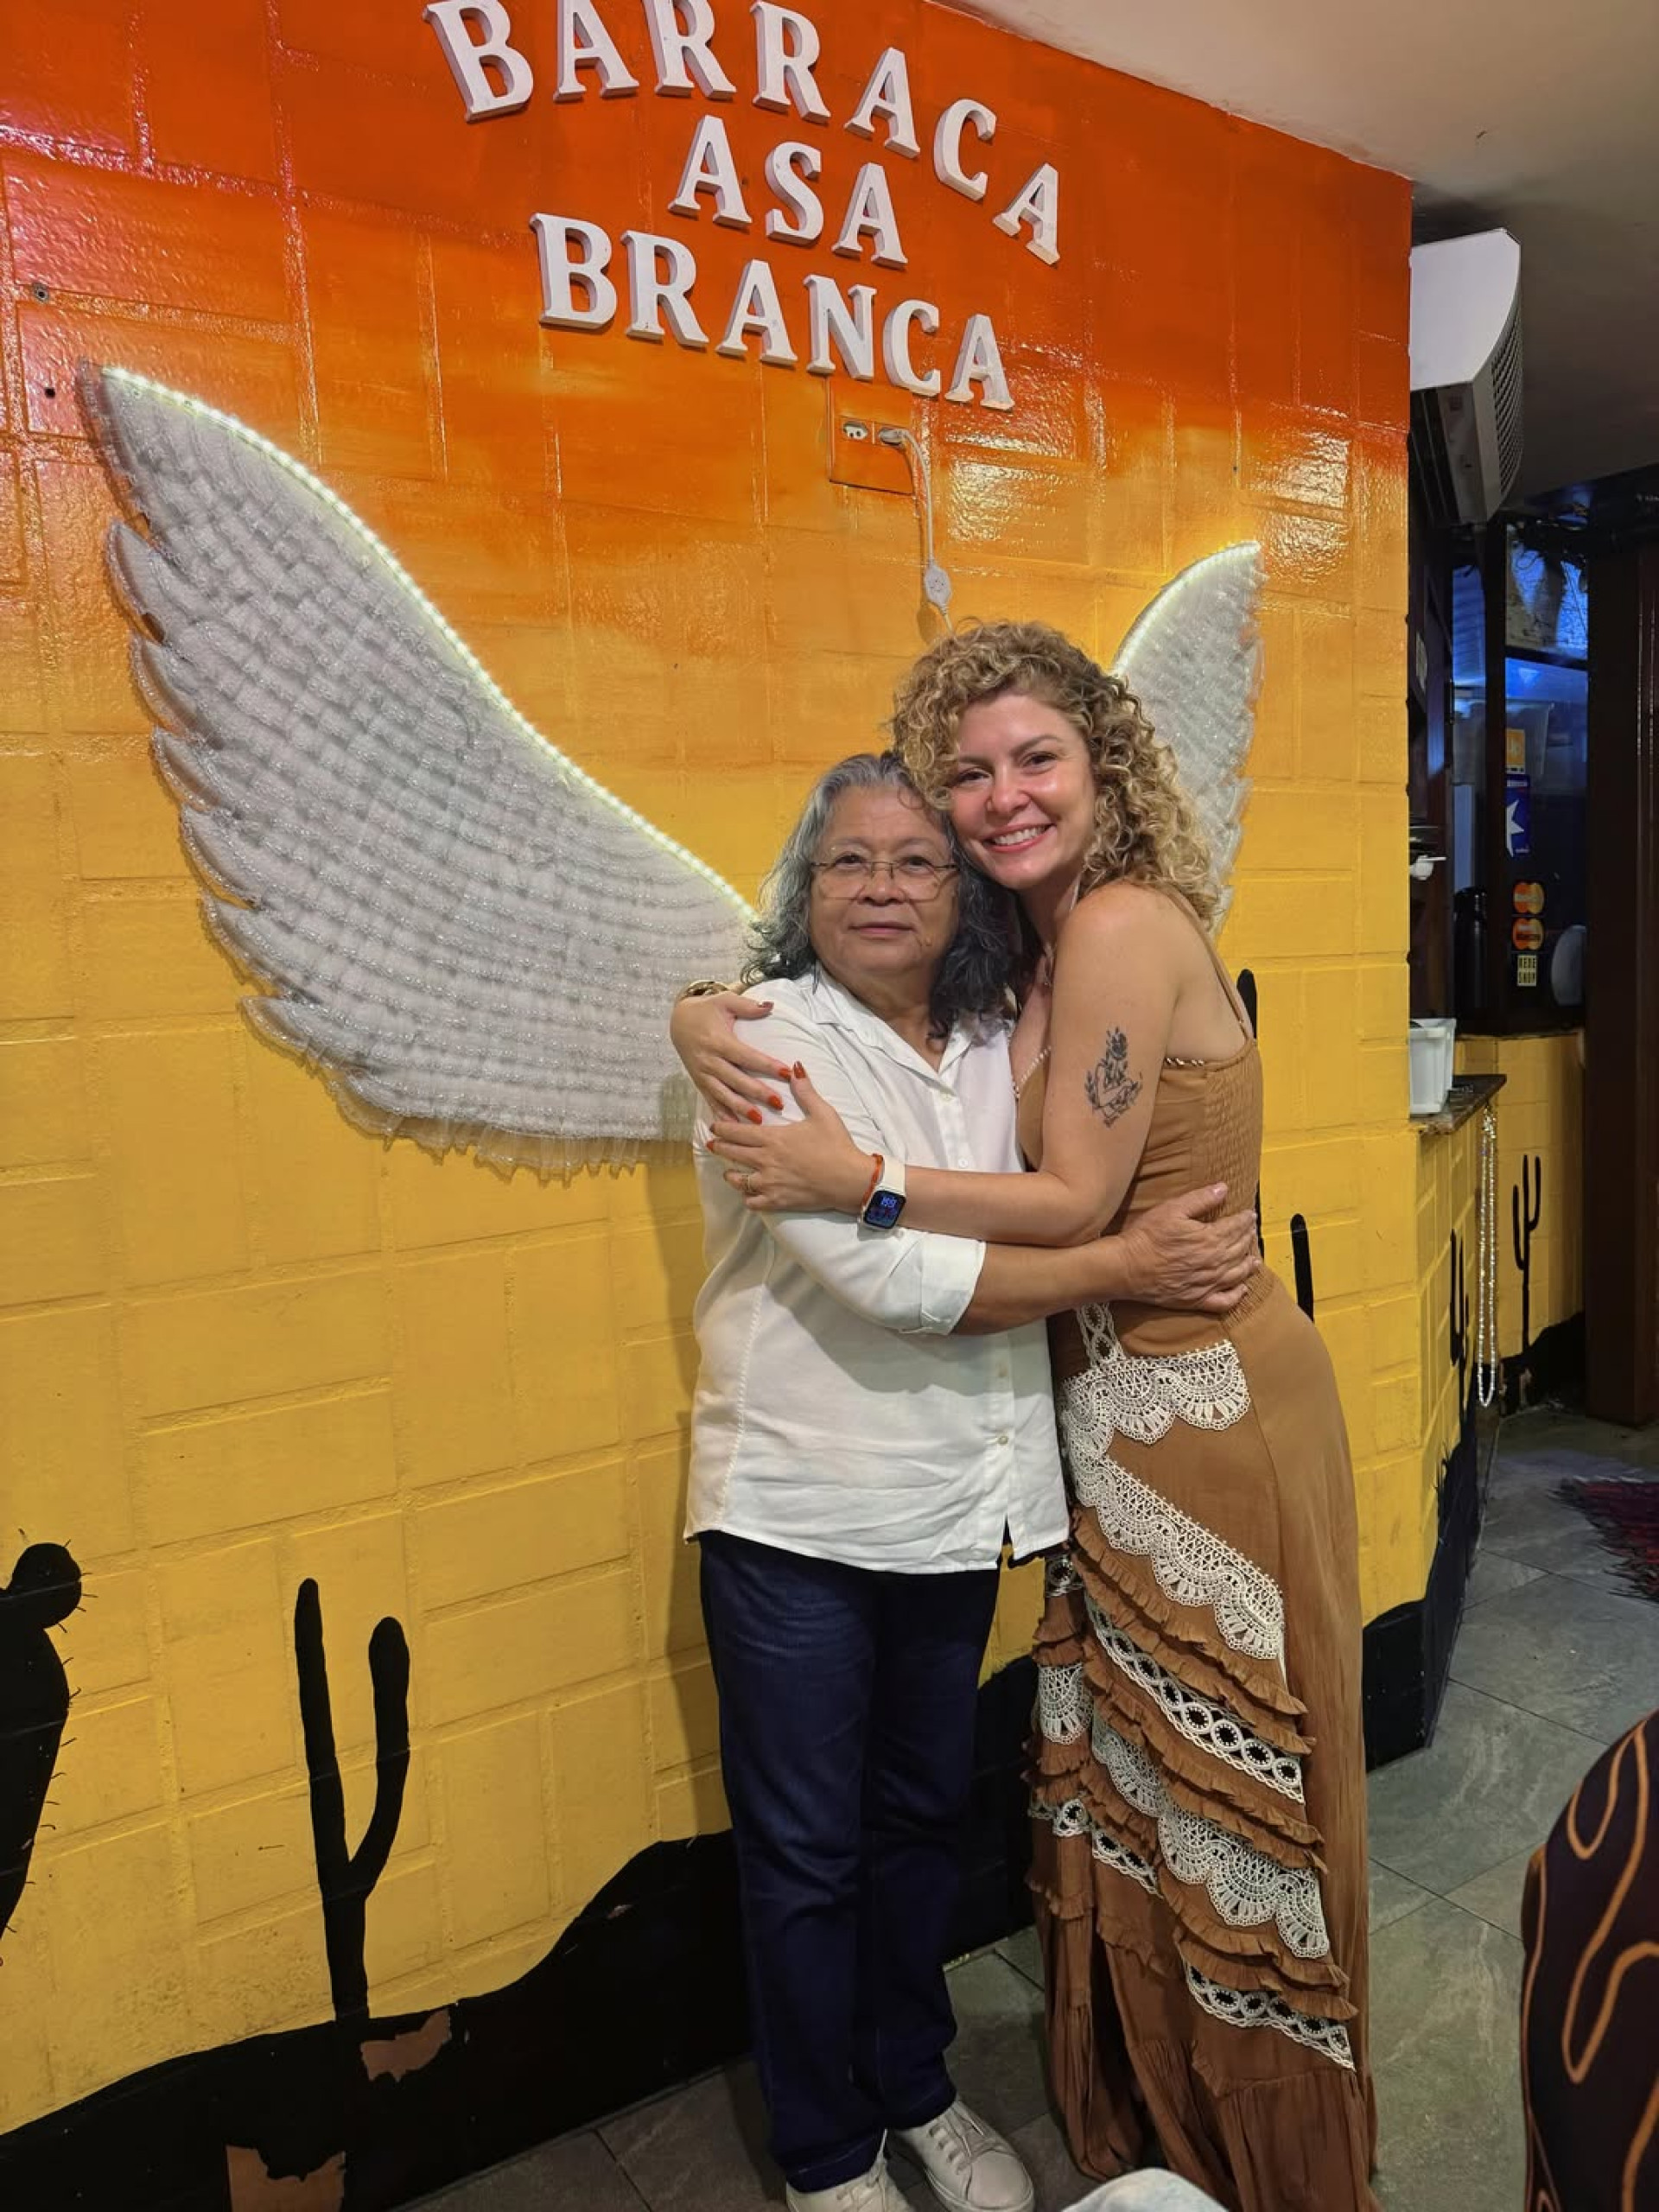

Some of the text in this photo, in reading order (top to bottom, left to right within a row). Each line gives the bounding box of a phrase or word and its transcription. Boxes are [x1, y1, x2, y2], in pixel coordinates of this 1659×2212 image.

[423, 0, 1060, 265] BARRACA
[668, 115, 907, 267] ASA
[529, 213, 1014, 410] BRANCA
